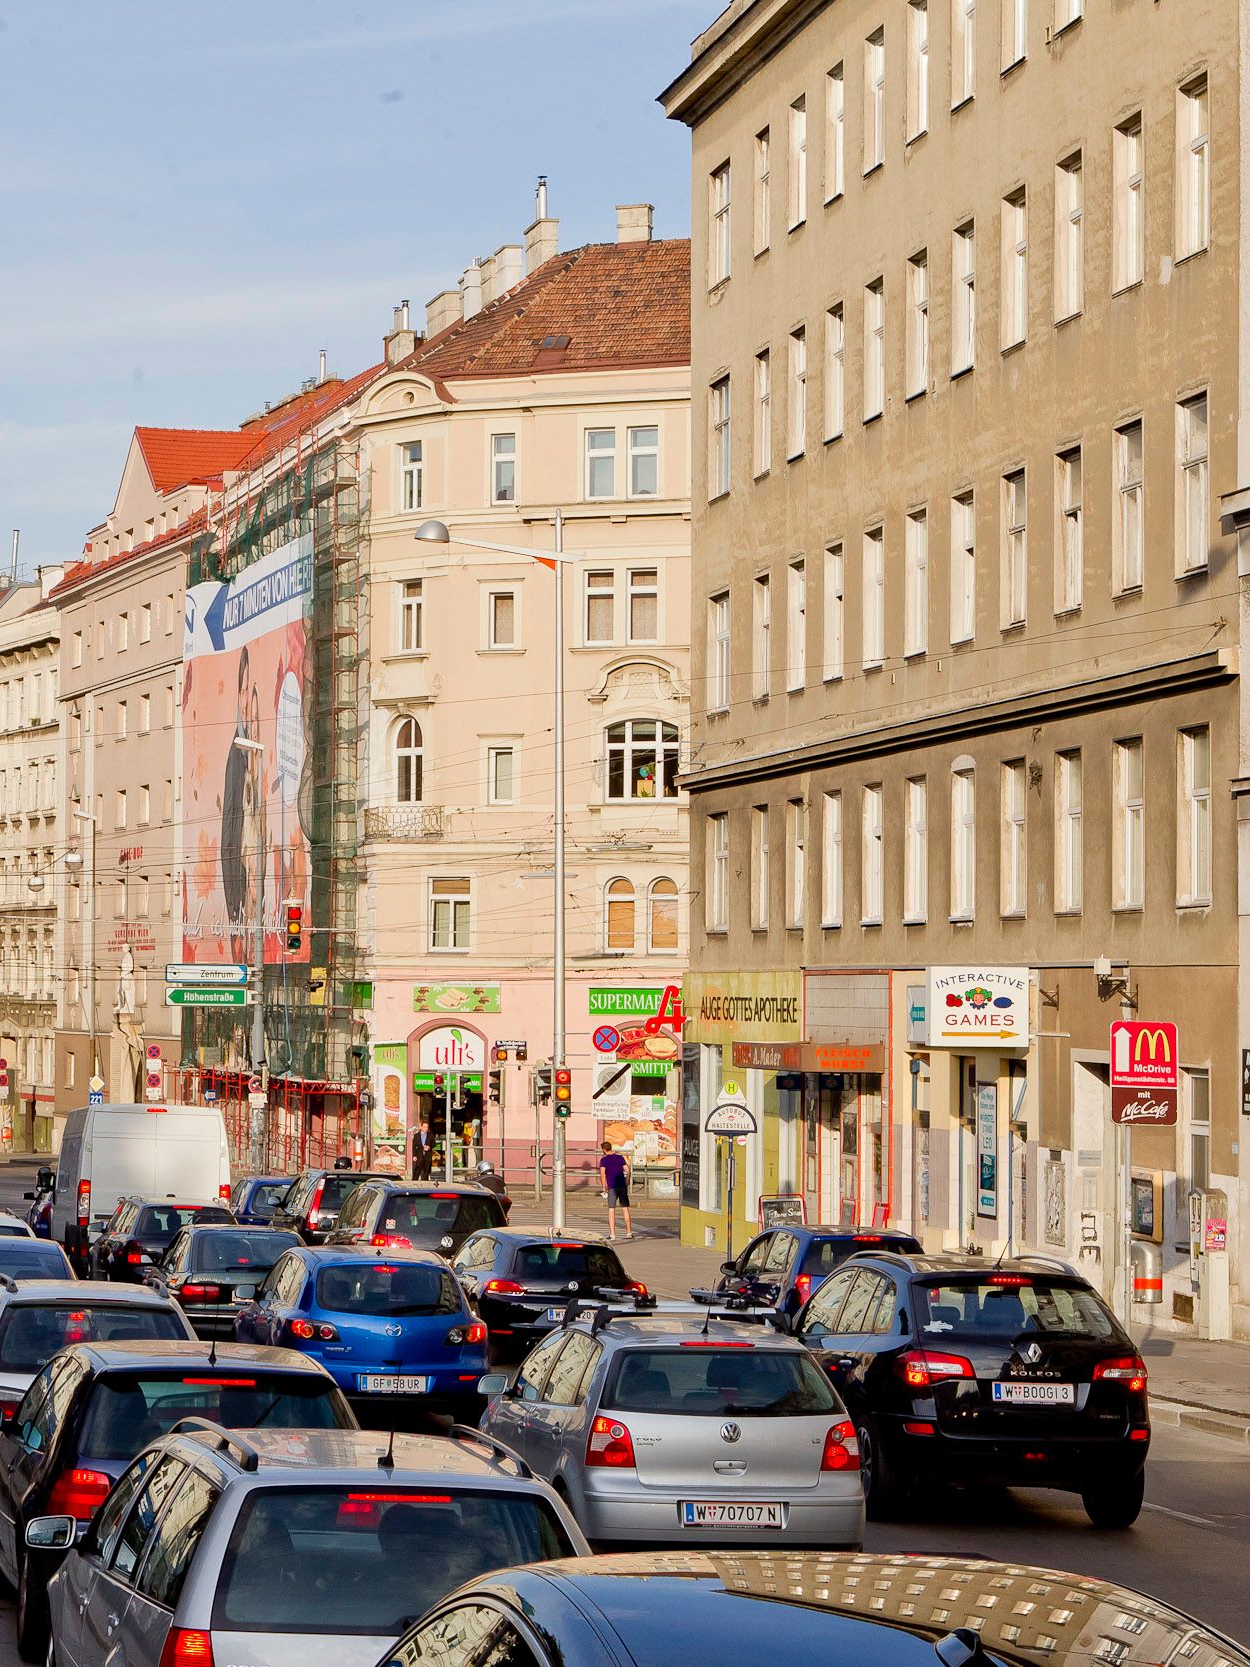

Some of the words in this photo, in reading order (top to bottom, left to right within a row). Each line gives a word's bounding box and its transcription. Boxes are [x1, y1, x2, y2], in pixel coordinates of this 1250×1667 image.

[223, 599, 239, 630] NUR
[244, 577, 271, 621] MINUTEN
[272, 569, 289, 604] VON
[200, 969, 234, 978] Zentrum
[935, 973, 1025, 990] INTERACTIVE
[183, 992, 234, 1001] Höhenstraße
[590, 993, 674, 1010] SUPERMAR
[700, 996, 721, 1021] AUGE
[722, 997, 753, 1021] GOTTES
[753, 997, 797, 1024] APOTHEKE
[945, 1014, 1015, 1026] GAMES
[435, 1037, 475, 1066] uli's
[820, 1060, 866, 1069] WURST
[1133, 1064, 1171, 1074] McDrive
[90, 1094, 103, 1104] 221
[1137, 1091, 1151, 1099] mit
[717, 1107, 746, 1118] AUTOBUS
[373, 1379, 384, 1389] GF
[393, 1379, 405, 1389] 58
[408, 1379, 420, 1389] UR
[1004, 1385, 1014, 1398] W
[696, 1505, 707, 1520] W
[719, 1506, 763, 1521] 70707
[768, 1507, 776, 1521] N
